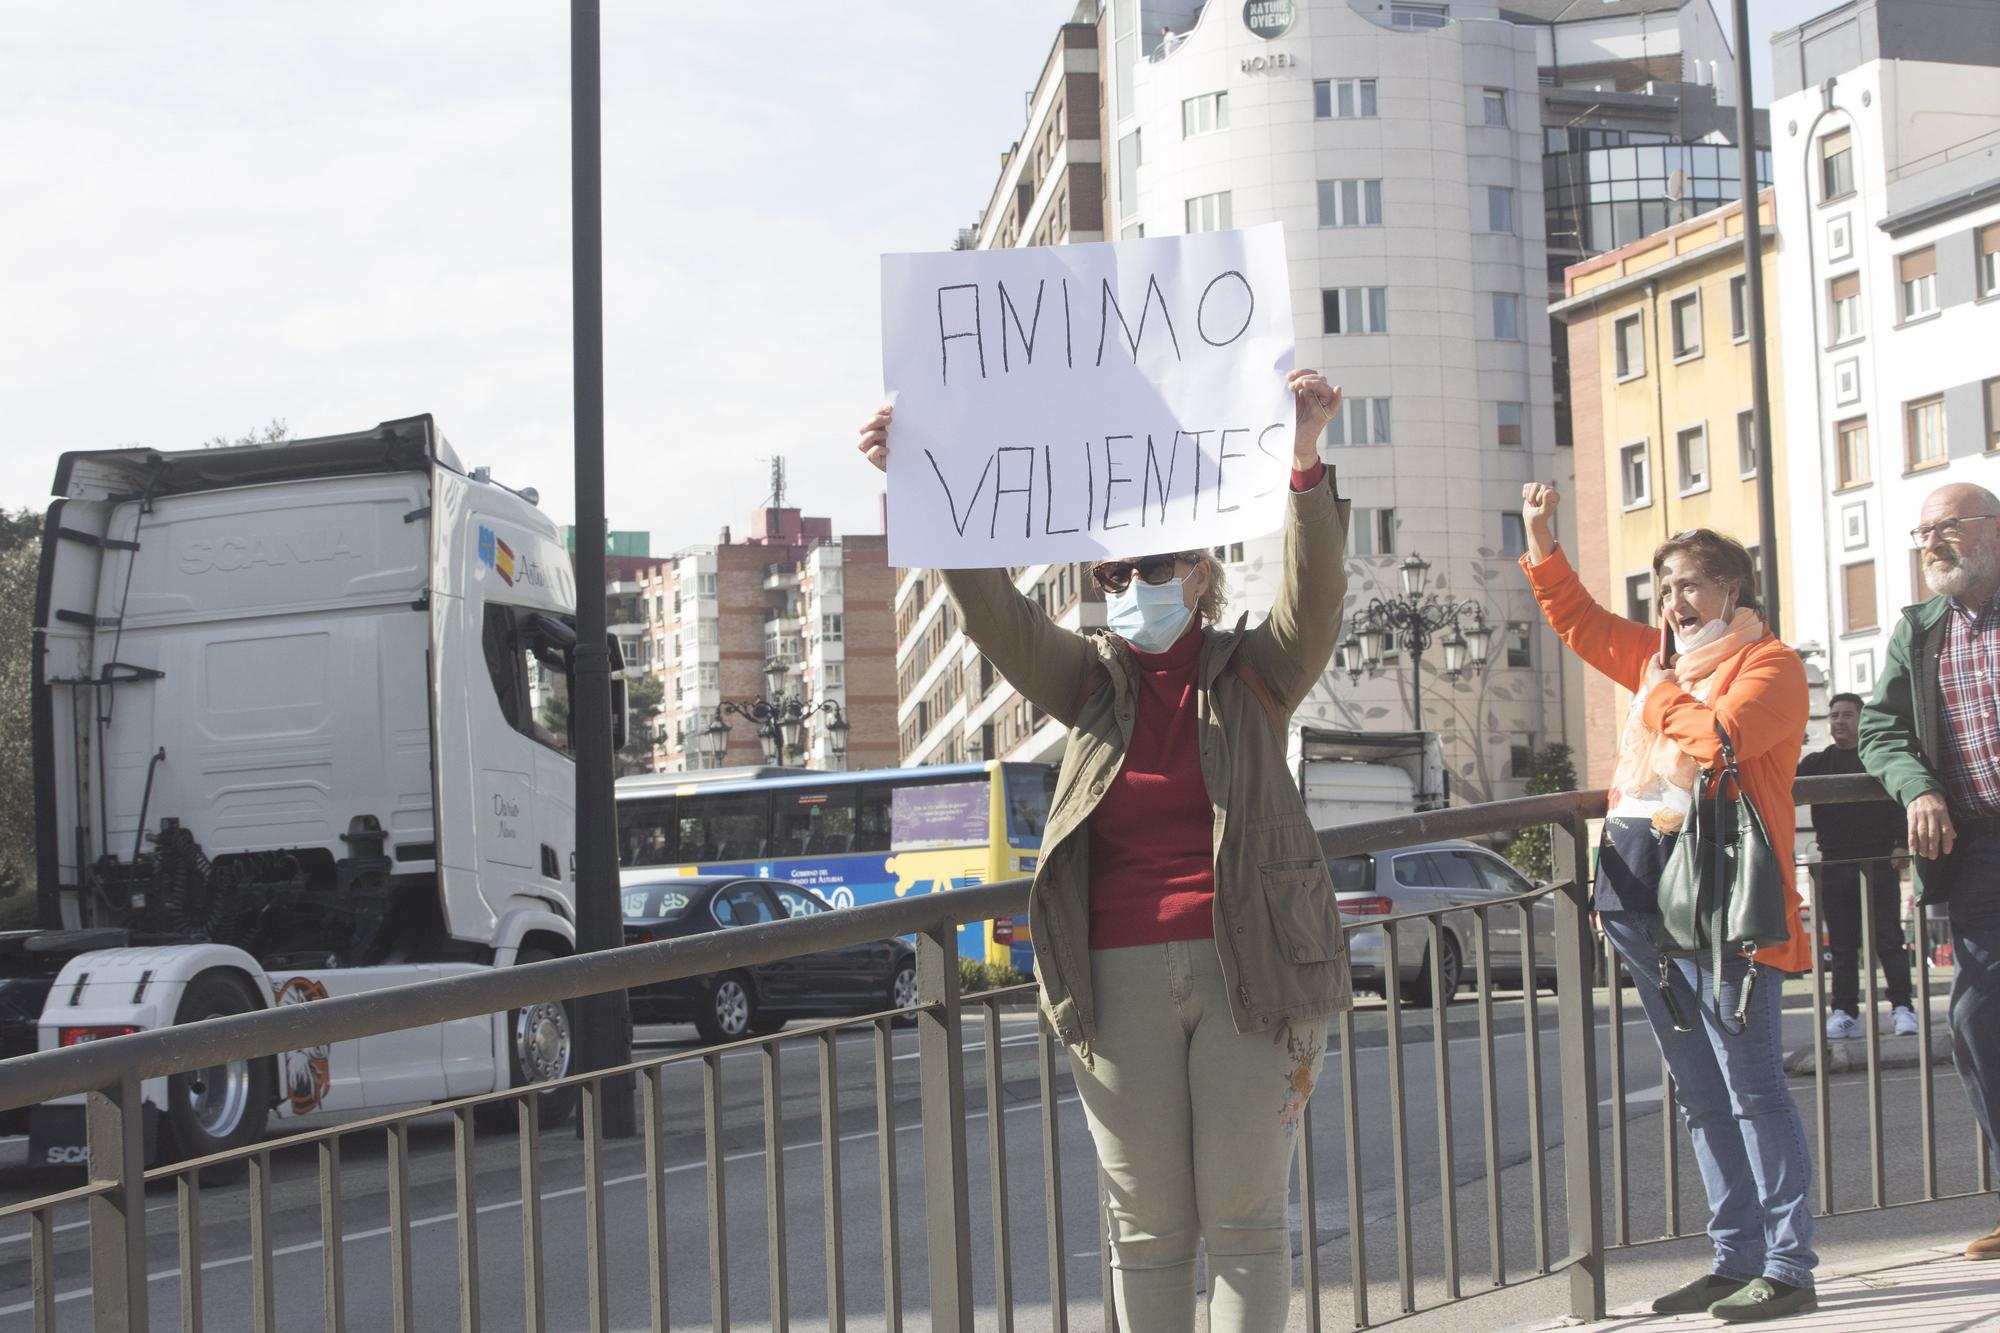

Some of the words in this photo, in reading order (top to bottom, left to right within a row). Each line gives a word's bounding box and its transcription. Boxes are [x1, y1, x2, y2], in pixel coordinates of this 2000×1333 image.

[1250, 13, 1290, 29] OVIEDO
[1241, 54, 1296, 72] HOTEL
[938, 270, 1255, 386] ANIMO
[924, 423, 1285, 538] VALIENTES
[179, 530, 361, 575] SCANIA
